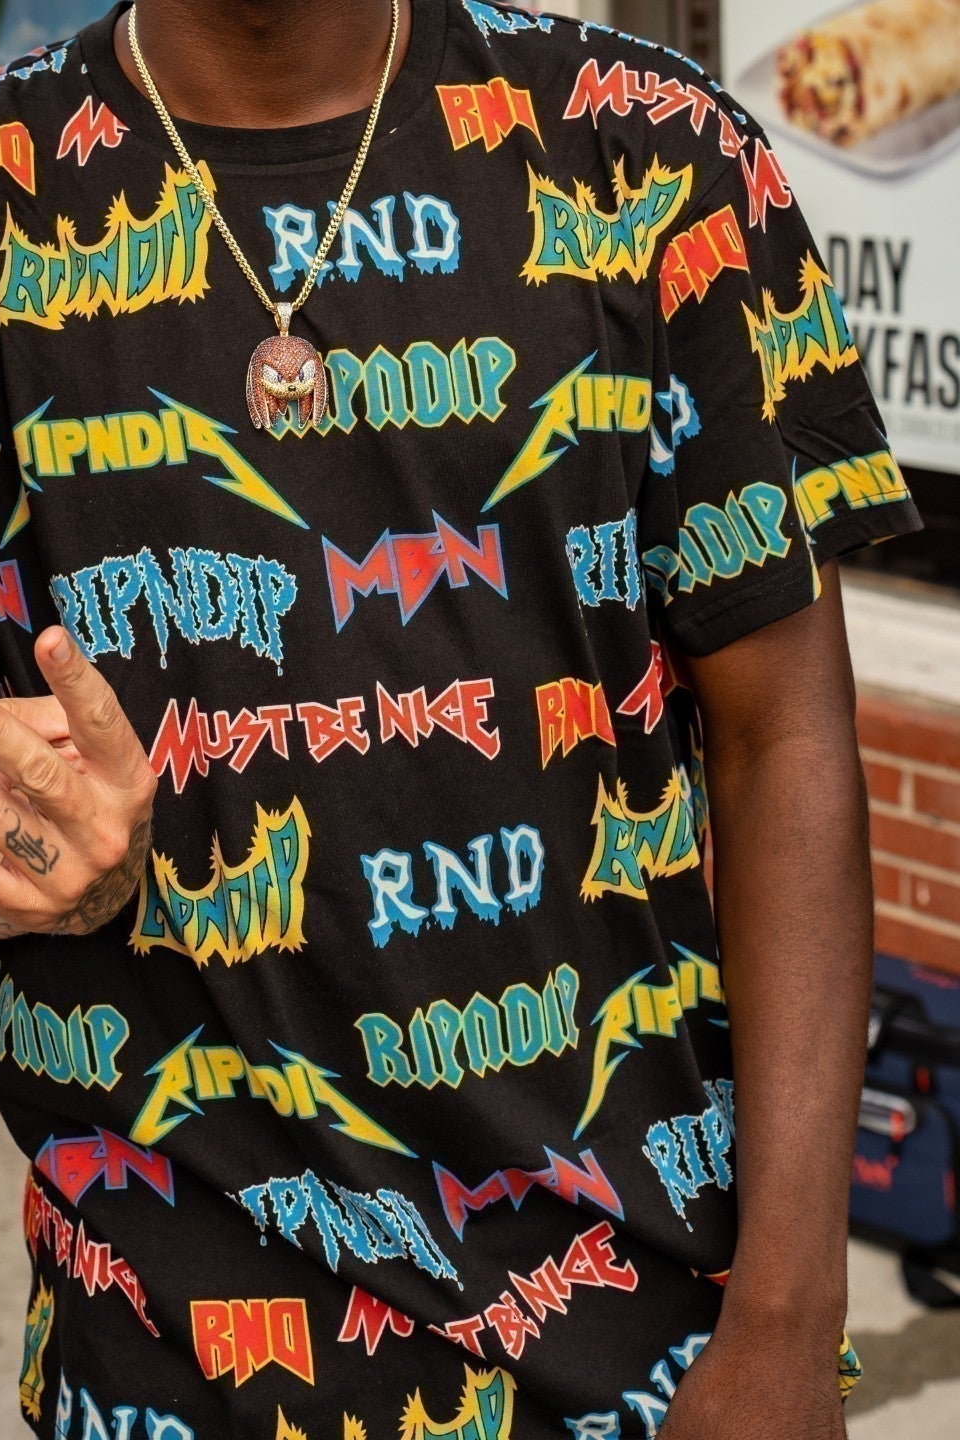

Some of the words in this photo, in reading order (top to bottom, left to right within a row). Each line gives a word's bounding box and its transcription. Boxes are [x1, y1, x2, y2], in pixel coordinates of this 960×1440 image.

[563, 58, 716, 137] MUST
[262, 190, 461, 293] RND
[828, 233, 910, 315] DAY
[268, 336, 517, 441] PNDIP
[149, 696, 292, 795] MUST
[296, 695, 371, 764] BE
[376, 677, 501, 761] NICE
[360, 823, 545, 949] RND
[353, 962, 580, 1091] RIPNDIP
[508, 1219, 640, 1320] NICE
